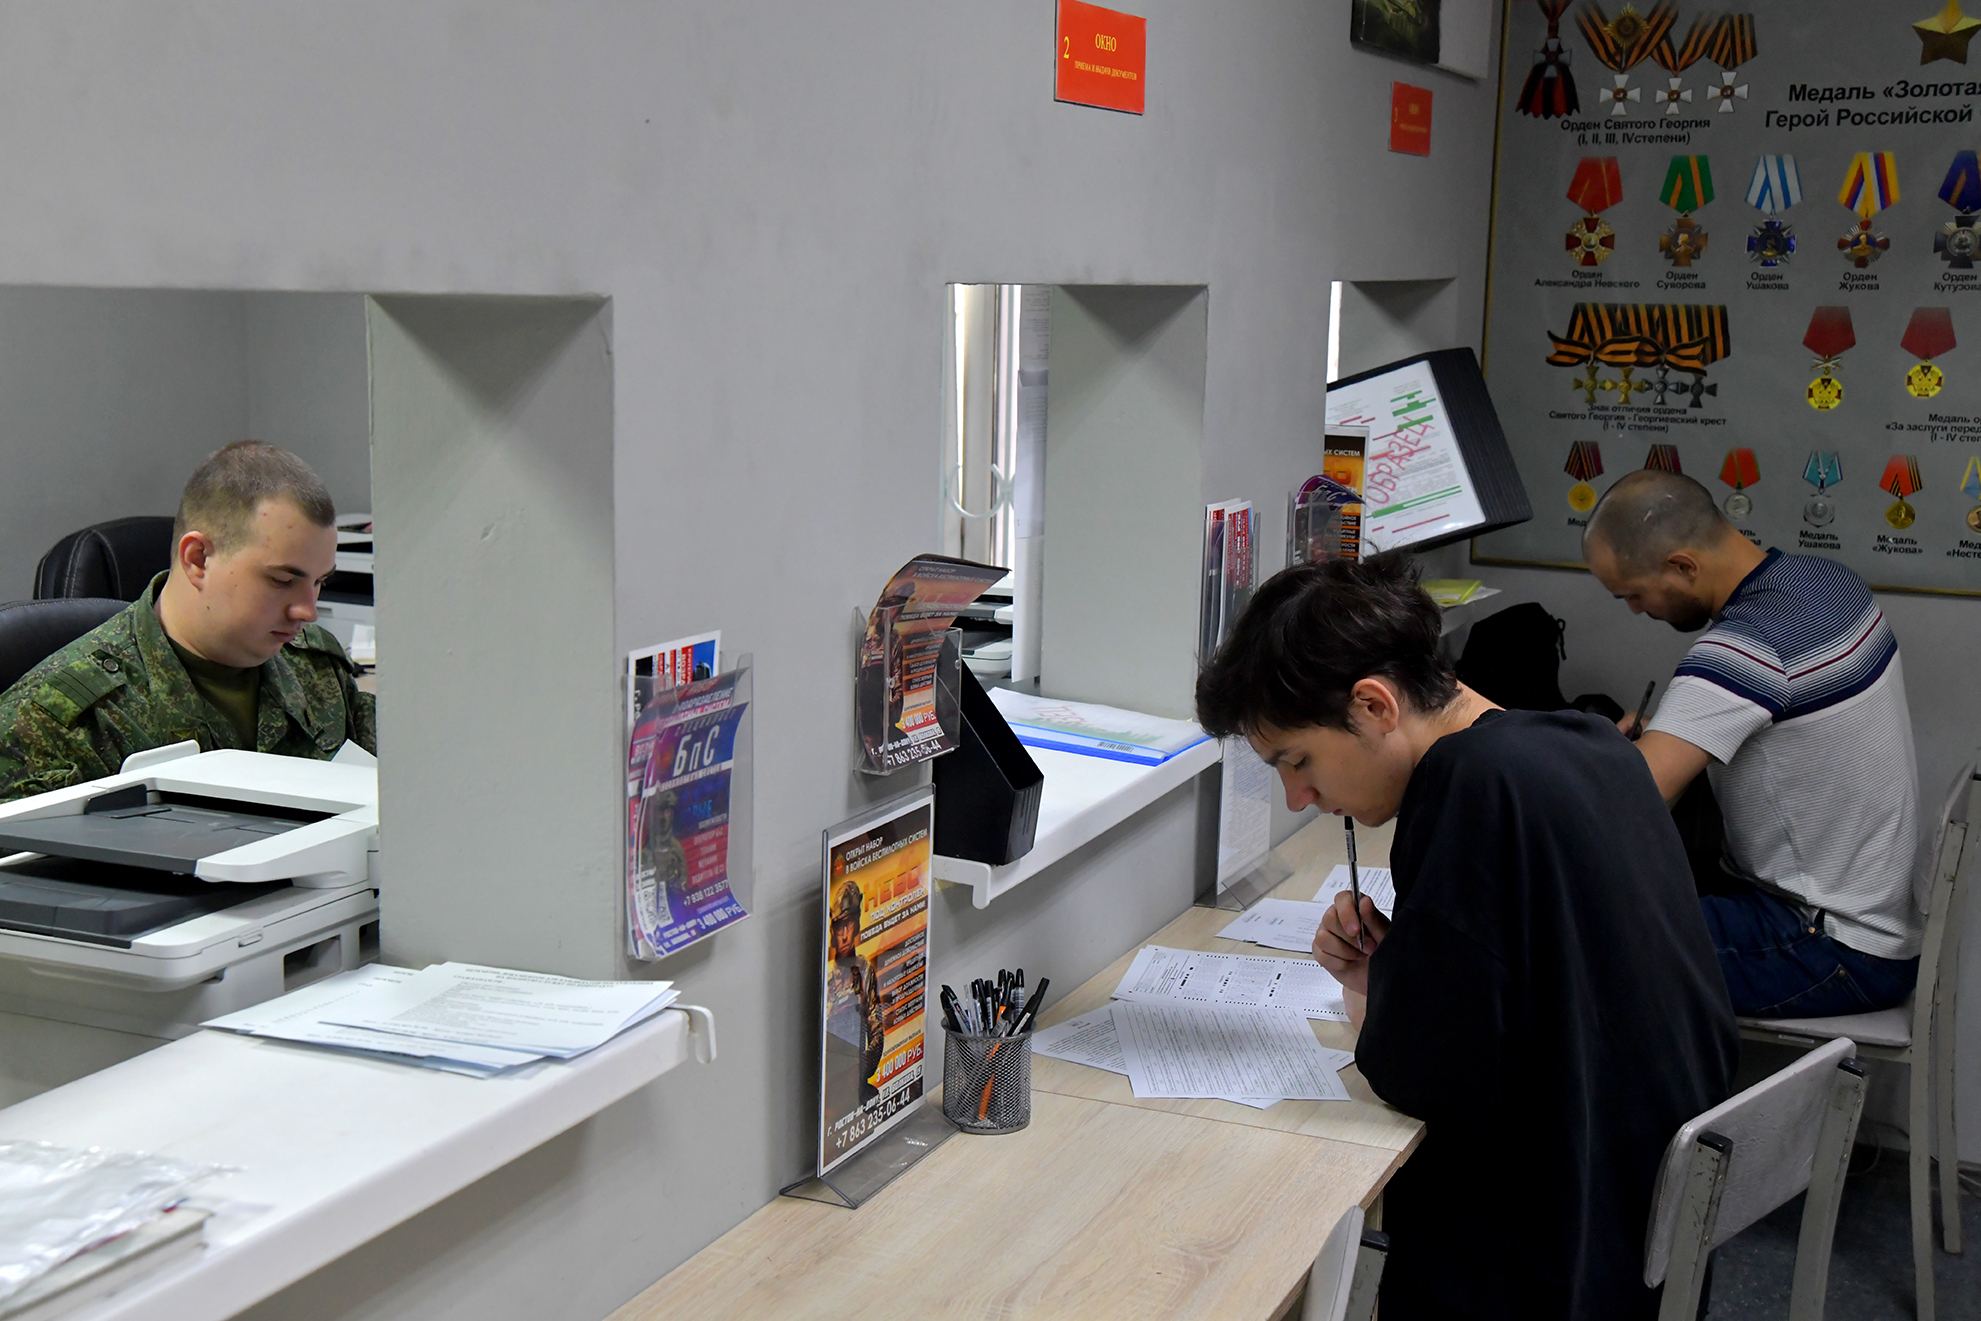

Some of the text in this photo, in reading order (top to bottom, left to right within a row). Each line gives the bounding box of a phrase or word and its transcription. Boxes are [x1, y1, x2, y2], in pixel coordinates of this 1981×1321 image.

[1063, 36, 1070, 59] 2
[1095, 33, 1117, 52] ОКНО
[1789, 83, 1876, 104] Медаль
[1765, 104, 1973, 131] Герой Российской
[1560, 118, 1710, 132] Орден Святого Георгия
[1571, 269, 1603, 281] Орден
[1665, 270, 1698, 281] Орден
[1750, 271, 1783, 282] Орден
[1842, 271, 1878, 282] Орден
[1942, 271, 1978, 283] Орден
[1534, 279, 1640, 289] Александра Невского
[1656, 280, 1706, 291] Суворова
[1746, 281, 1789, 291] Ушакова
[1838, 282, 1880, 292] Жукова
[1587, 403, 1687, 415] Знак отличия ордена
[1549, 411, 1586, 420] Святого
[1588, 412, 1625, 422] Георгия
[1633, 414, 1698, 425] Георгиевский
[1700, 418, 1727, 427] крест
[1928, 413, 1970, 424] Медаль
[1885, 421, 1904, 431] «За
[1906, 423, 1948, 433] заслуги
[1366, 416, 1435, 504] ОБРАЗЕЦ
[1799, 529, 1838, 541] Медаль
[1798, 540, 1841, 550] Ушакова
[1872, 544, 1923, 555] «Жукова»
[846, 836, 884, 860] ОТКРЫТ НАБОР
[849, 855, 872, 873] ВОЙСКА
[908, 828, 928, 844] СИСТЕМ
[860, 923, 882, 941] ПОБЕДА
[901, 909, 910, 919] ЗА
[910, 900, 926, 914] НАМИ
[870, 907, 885, 923] ПОД
[882, 1059, 894, 1079] 400
[907, 1042, 923, 1062] РУБ.
[836, 1087, 910, 1149] +7 863 235-06-44
